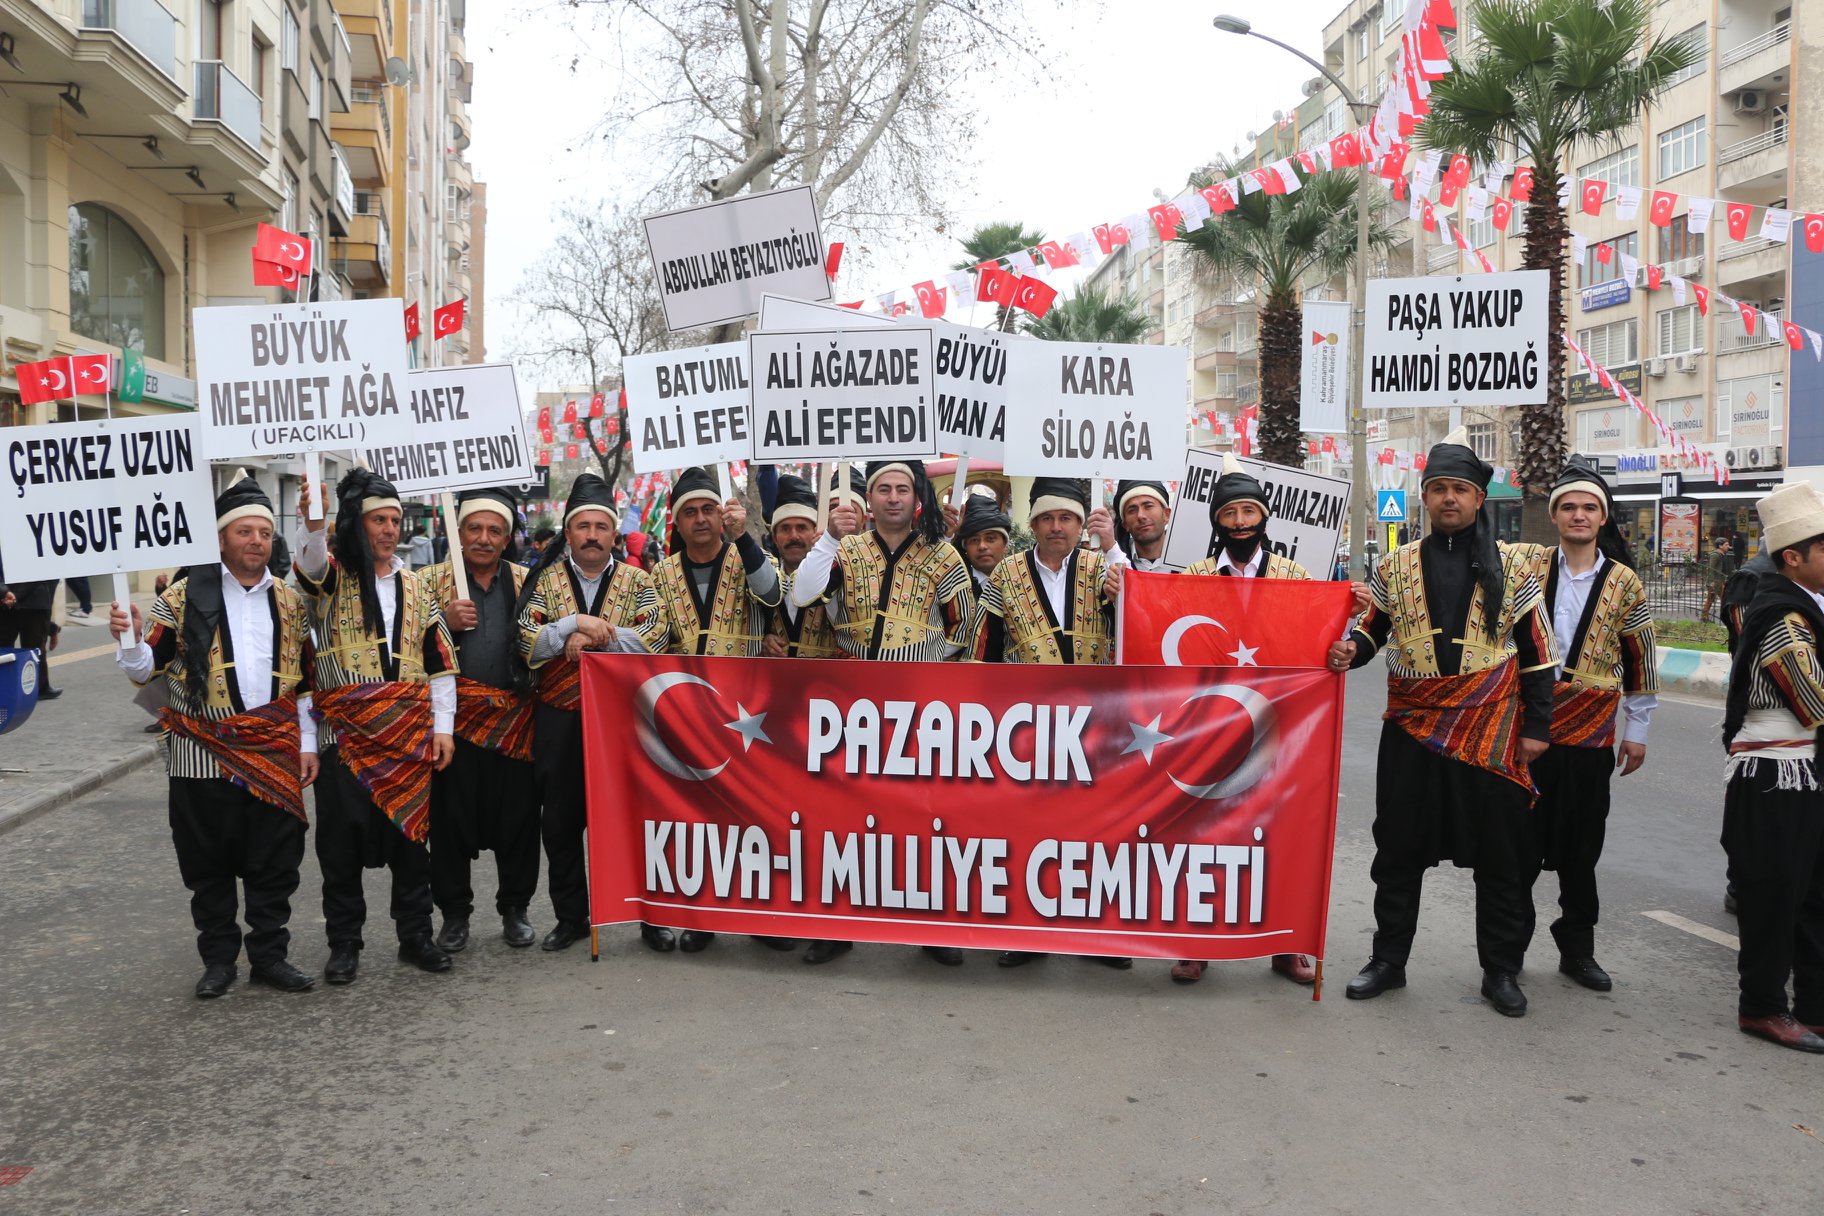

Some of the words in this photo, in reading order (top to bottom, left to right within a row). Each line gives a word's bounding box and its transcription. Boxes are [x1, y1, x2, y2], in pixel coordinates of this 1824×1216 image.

[662, 250, 731, 295] ABDULLAH
[730, 226, 818, 281] BEYAZITOĞLU
[251, 311, 351, 366] BÜYÜK
[1389, 293, 1442, 340] PAŞA
[1449, 289, 1522, 328] YAKUP
[145, 374, 159, 393] EB
[656, 356, 748, 399] BATUML
[767, 343, 802, 389] ALİ
[811, 342, 919, 387] AĞAZADE
[1062, 356, 1133, 395] KARA
[1320, 345, 1328, 402] Kahramanmaraş
[1372, 345, 1439, 392] HAMDİ
[1448, 342, 1537, 391] BOZDAĞ
[210, 377, 329, 426] MEHMET
[341, 363, 399, 417] AĞA
[938, 394, 988, 438] MAN
[643, 405, 685, 451] ALİ
[694, 405, 749, 445] EFE
[764, 400, 809, 446] ALİ
[818, 396, 926, 445] EFENDİ
[1042, 418, 1095, 459] SİLO
[1103, 412, 1152, 460] AĞA
[9, 435, 115, 498] ÇERKEZ
[121, 429, 193, 477] UZUN
[366, 441, 448, 482] MEHMET
[453, 426, 521, 473] EFENDİ
[26, 507, 122, 557] YUSUF
[135, 492, 192, 548] AĞA
[808, 699, 1092, 781] PAZARCIK
[644, 812, 802, 901] KUVA-İ
[821, 815, 1007, 914] MİLLİYE
[1026, 824, 1264, 923] CEMİYETİ
